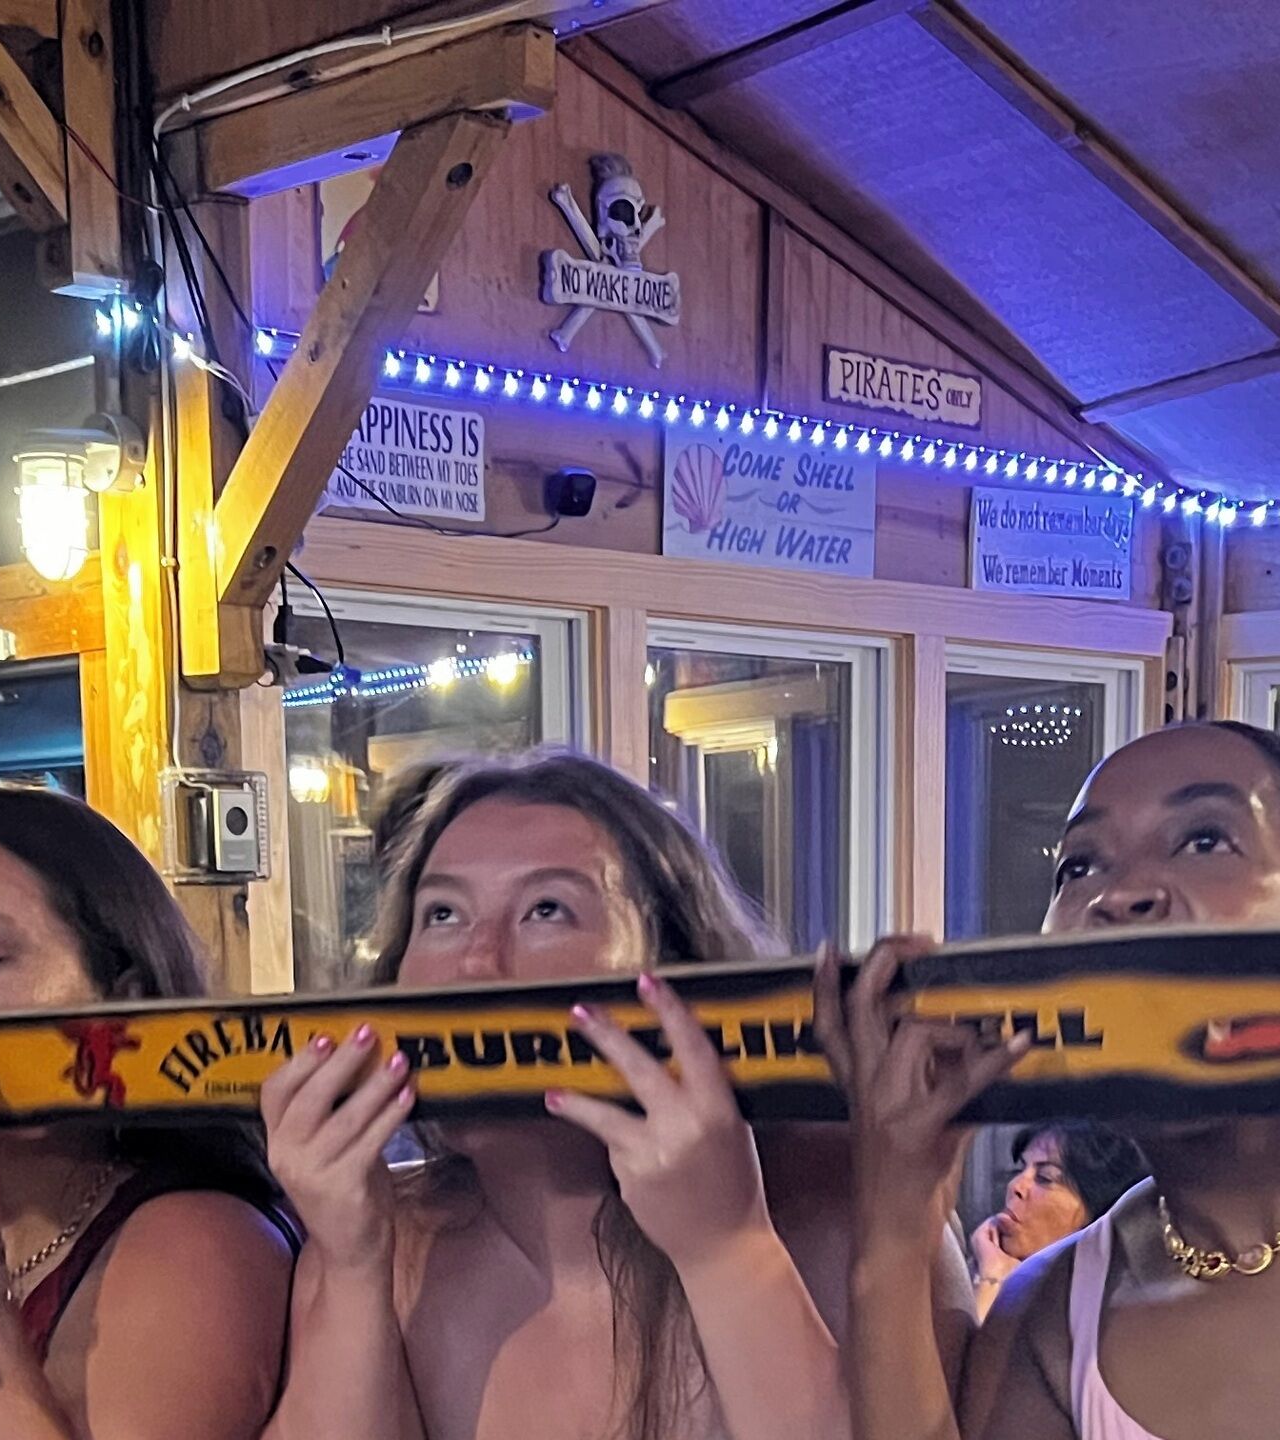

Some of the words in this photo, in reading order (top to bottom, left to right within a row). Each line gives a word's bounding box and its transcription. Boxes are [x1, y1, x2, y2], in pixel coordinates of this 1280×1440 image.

[561, 264, 581, 294] NO
[586, 270, 629, 304] WAKE
[634, 277, 671, 310] ZONE
[840, 357, 942, 411] PIRATES
[358, 403, 453, 454] PPINESS
[461, 416, 479, 458] IS
[339, 446, 355, 471] HE
[357, 449, 386, 475] SAND
[389, 452, 434, 481] BETWEEN
[437, 458, 450, 484] MY
[453, 461, 479, 487] TOES
[721, 443, 786, 482] COME
[793, 452, 855, 491] SHELL
[336, 476, 357, 498] AND
[378, 481, 421, 506] SUNBURN
[423, 486, 438, 508] ON
[441, 489, 453, 510] MY
[456, 492, 479, 514] NOSE
[776, 491, 801, 514] OR
[978, 497, 998, 528] We
[1000, 500, 1016, 530] do
[1019, 502, 1040, 532] not
[706, 519, 767, 556] HIGH
[775, 525, 852, 565] WATER
[982, 554, 1003, 584] We
[1005, 557, 1068, 587] remember
[1071, 558, 1123, 589] Moments
[158, 1012, 302, 1094] FIREBA
[705, 1018, 830, 1060] LIK
